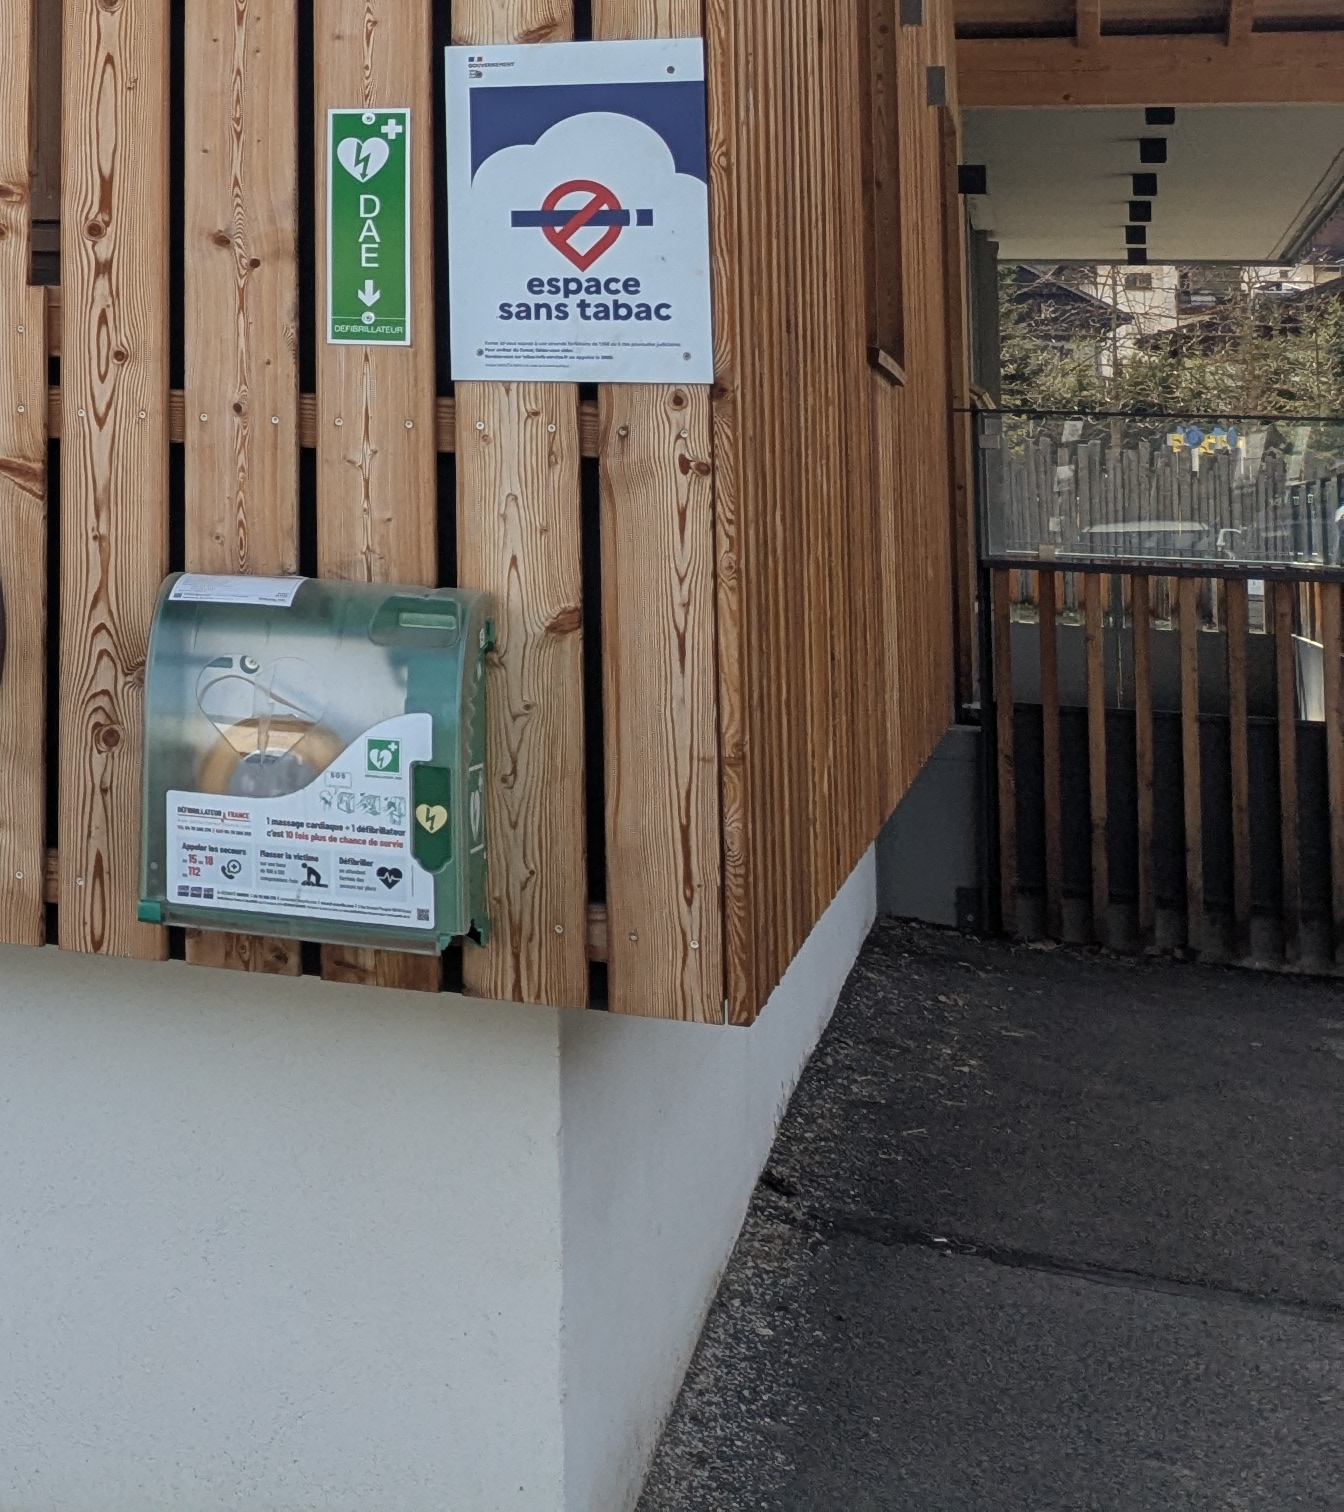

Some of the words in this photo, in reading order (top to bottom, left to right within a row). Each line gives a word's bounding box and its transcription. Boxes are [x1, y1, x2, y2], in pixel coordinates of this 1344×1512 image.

[358, 194, 381, 268] DAE
[526, 276, 641, 299] espace
[498, 302, 570, 321] sans
[576, 299, 672, 321] tabac
[271, 819, 305, 829] massage
[306, 821, 343, 832] cardiaque
[188, 853, 198, 864] 15
[188, 866, 201, 877] 112
